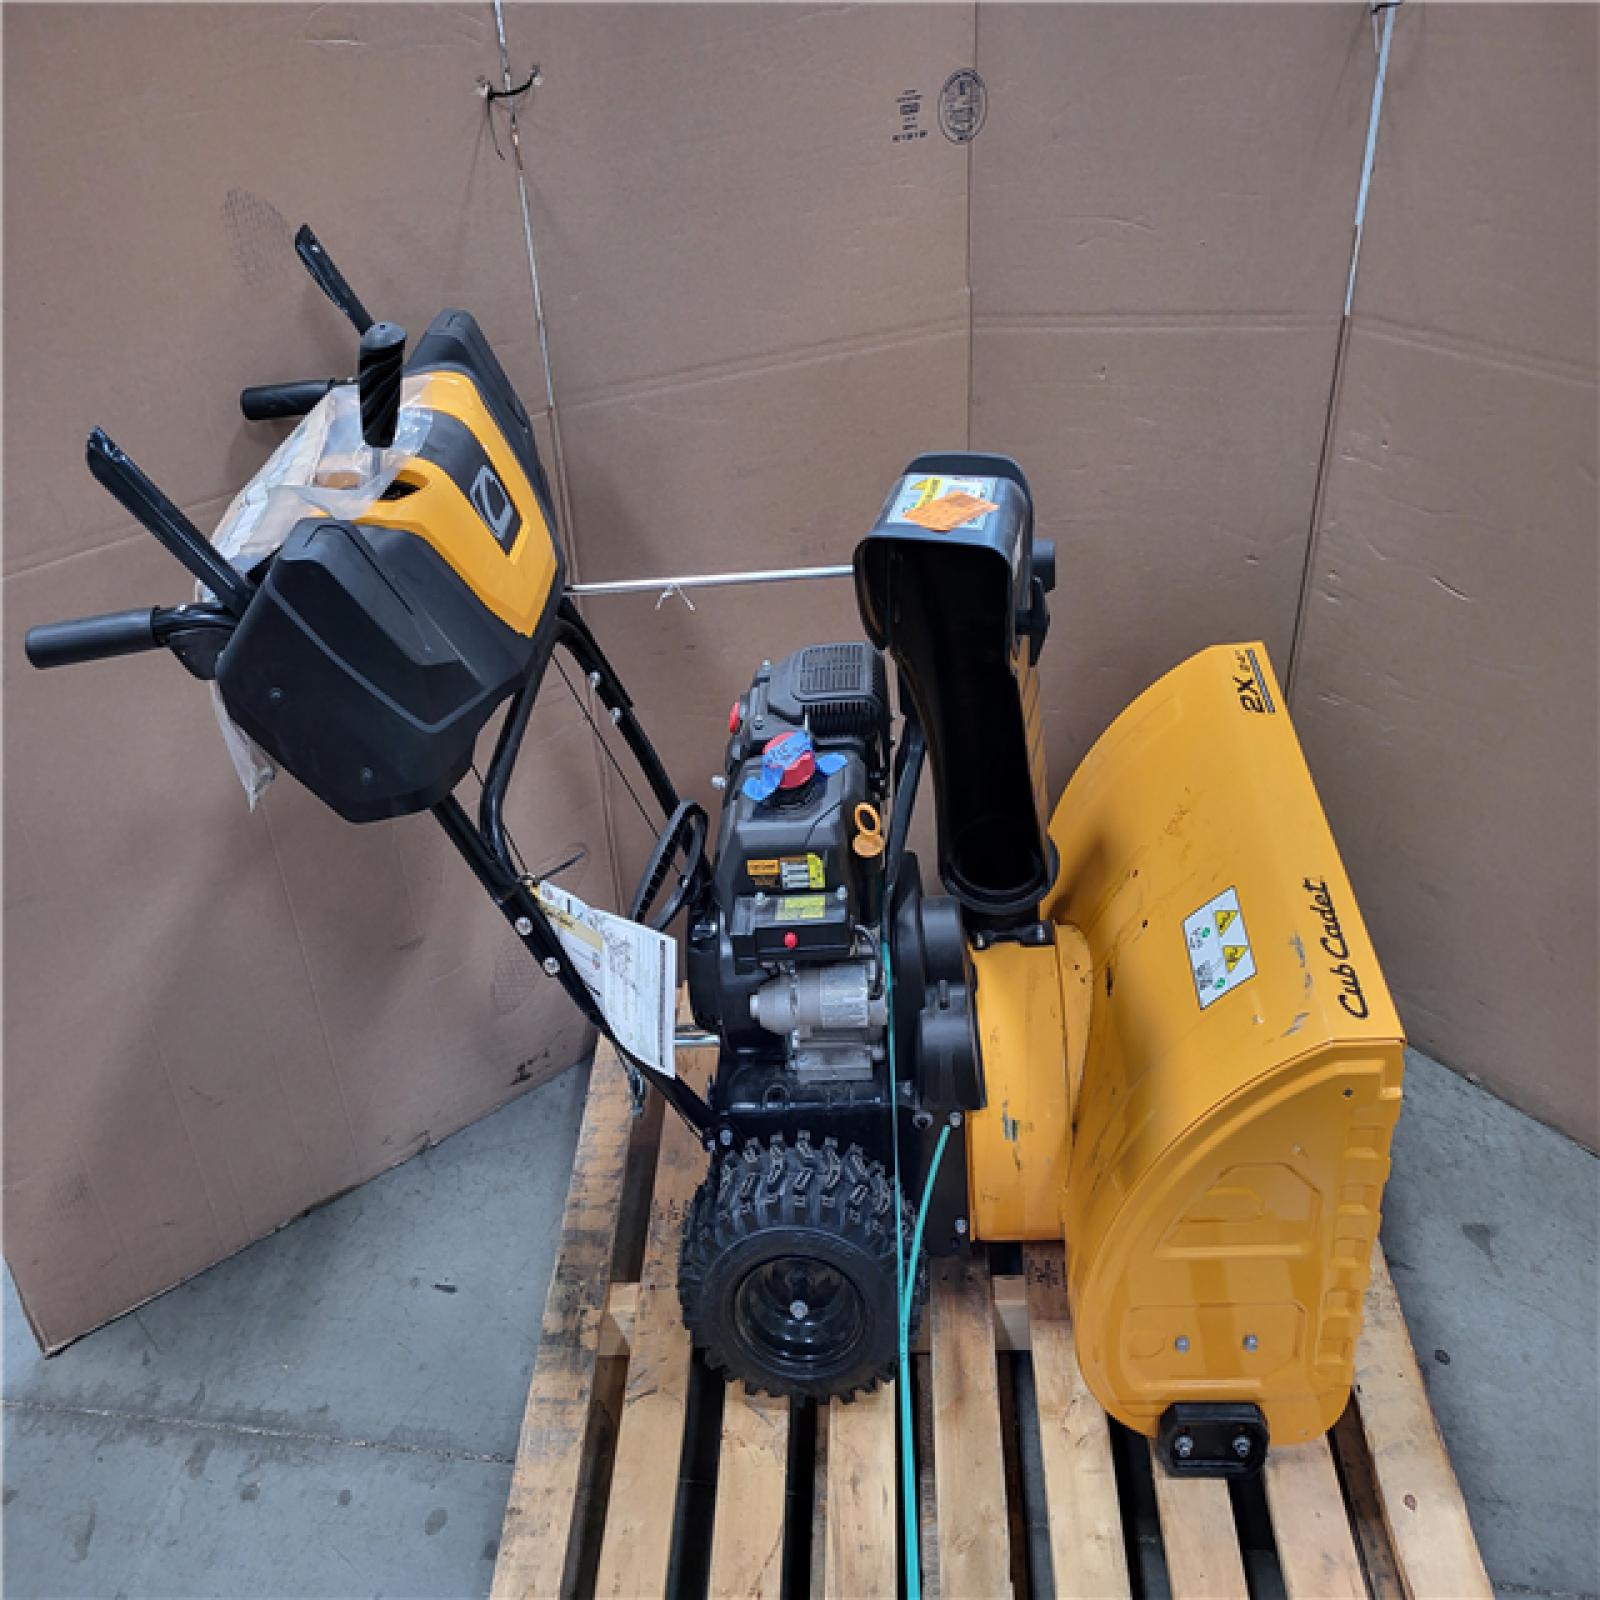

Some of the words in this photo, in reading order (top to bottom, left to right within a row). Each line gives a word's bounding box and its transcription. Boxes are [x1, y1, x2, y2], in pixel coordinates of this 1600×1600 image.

[1233, 675, 1265, 713] 2X
[1302, 875, 1350, 961] Cadet
[1330, 963, 1368, 1019] Cub
